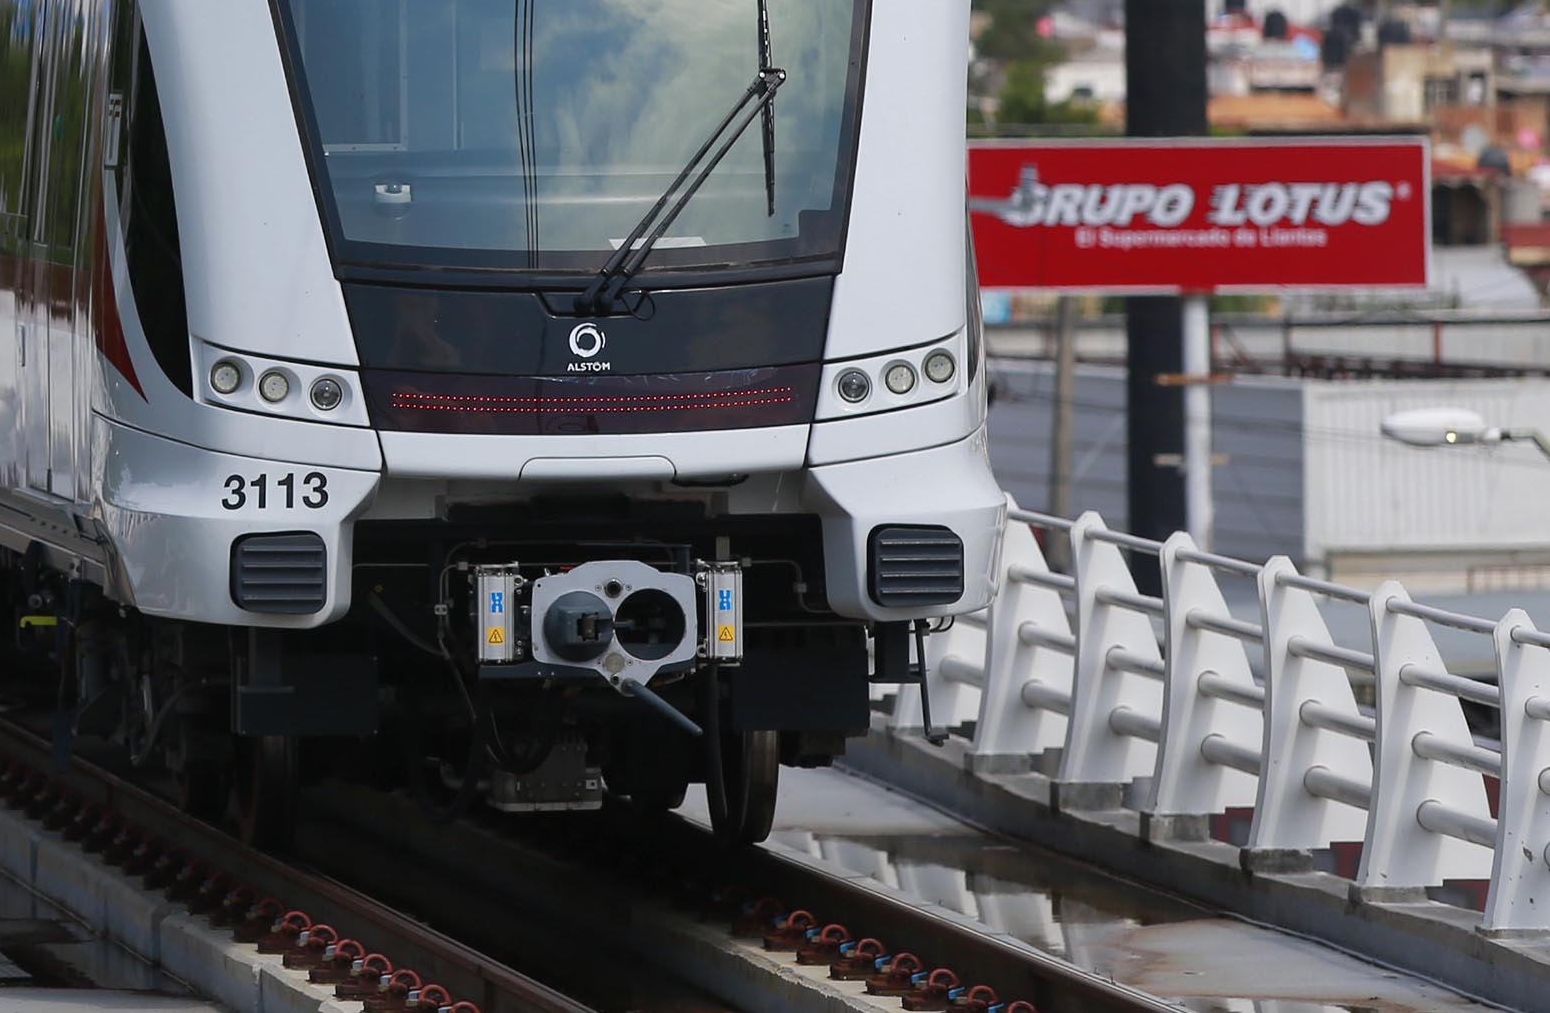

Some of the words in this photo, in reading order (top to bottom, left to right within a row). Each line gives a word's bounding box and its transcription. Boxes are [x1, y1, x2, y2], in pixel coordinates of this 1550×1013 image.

[1003, 182, 1195, 227] GRUPO
[1207, 181, 1394, 226] LOTUS
[1076, 227, 1096, 248] El
[1233, 228, 1257, 247] de
[567, 362, 611, 372] ALSTOM
[221, 471, 329, 510] 3113
